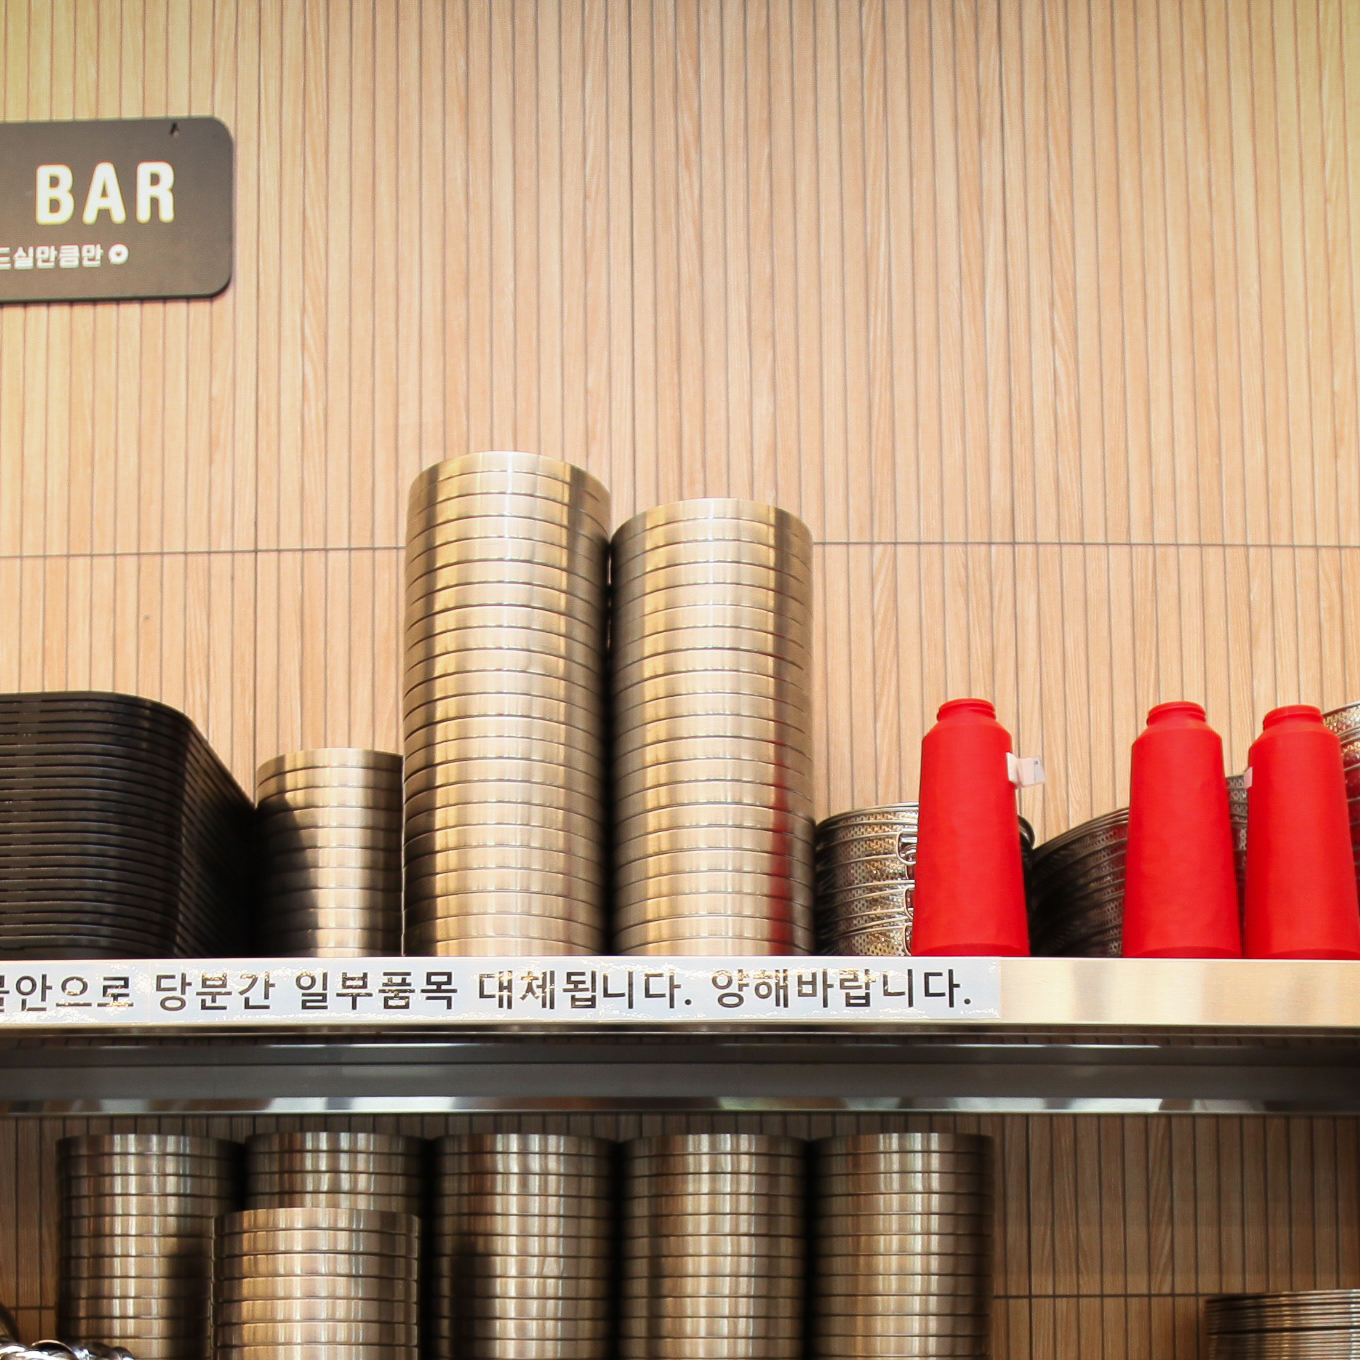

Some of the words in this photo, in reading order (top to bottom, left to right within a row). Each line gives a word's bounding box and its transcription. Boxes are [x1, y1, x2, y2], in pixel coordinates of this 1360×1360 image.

[35, 160, 176, 226] BAR
[155, 970, 274, 1012] 당분간
[294, 968, 459, 1011] 일부품목
[478, 967, 693, 1010] 대체됩니다.
[709, 966, 972, 1009] 양해바랍니다.
